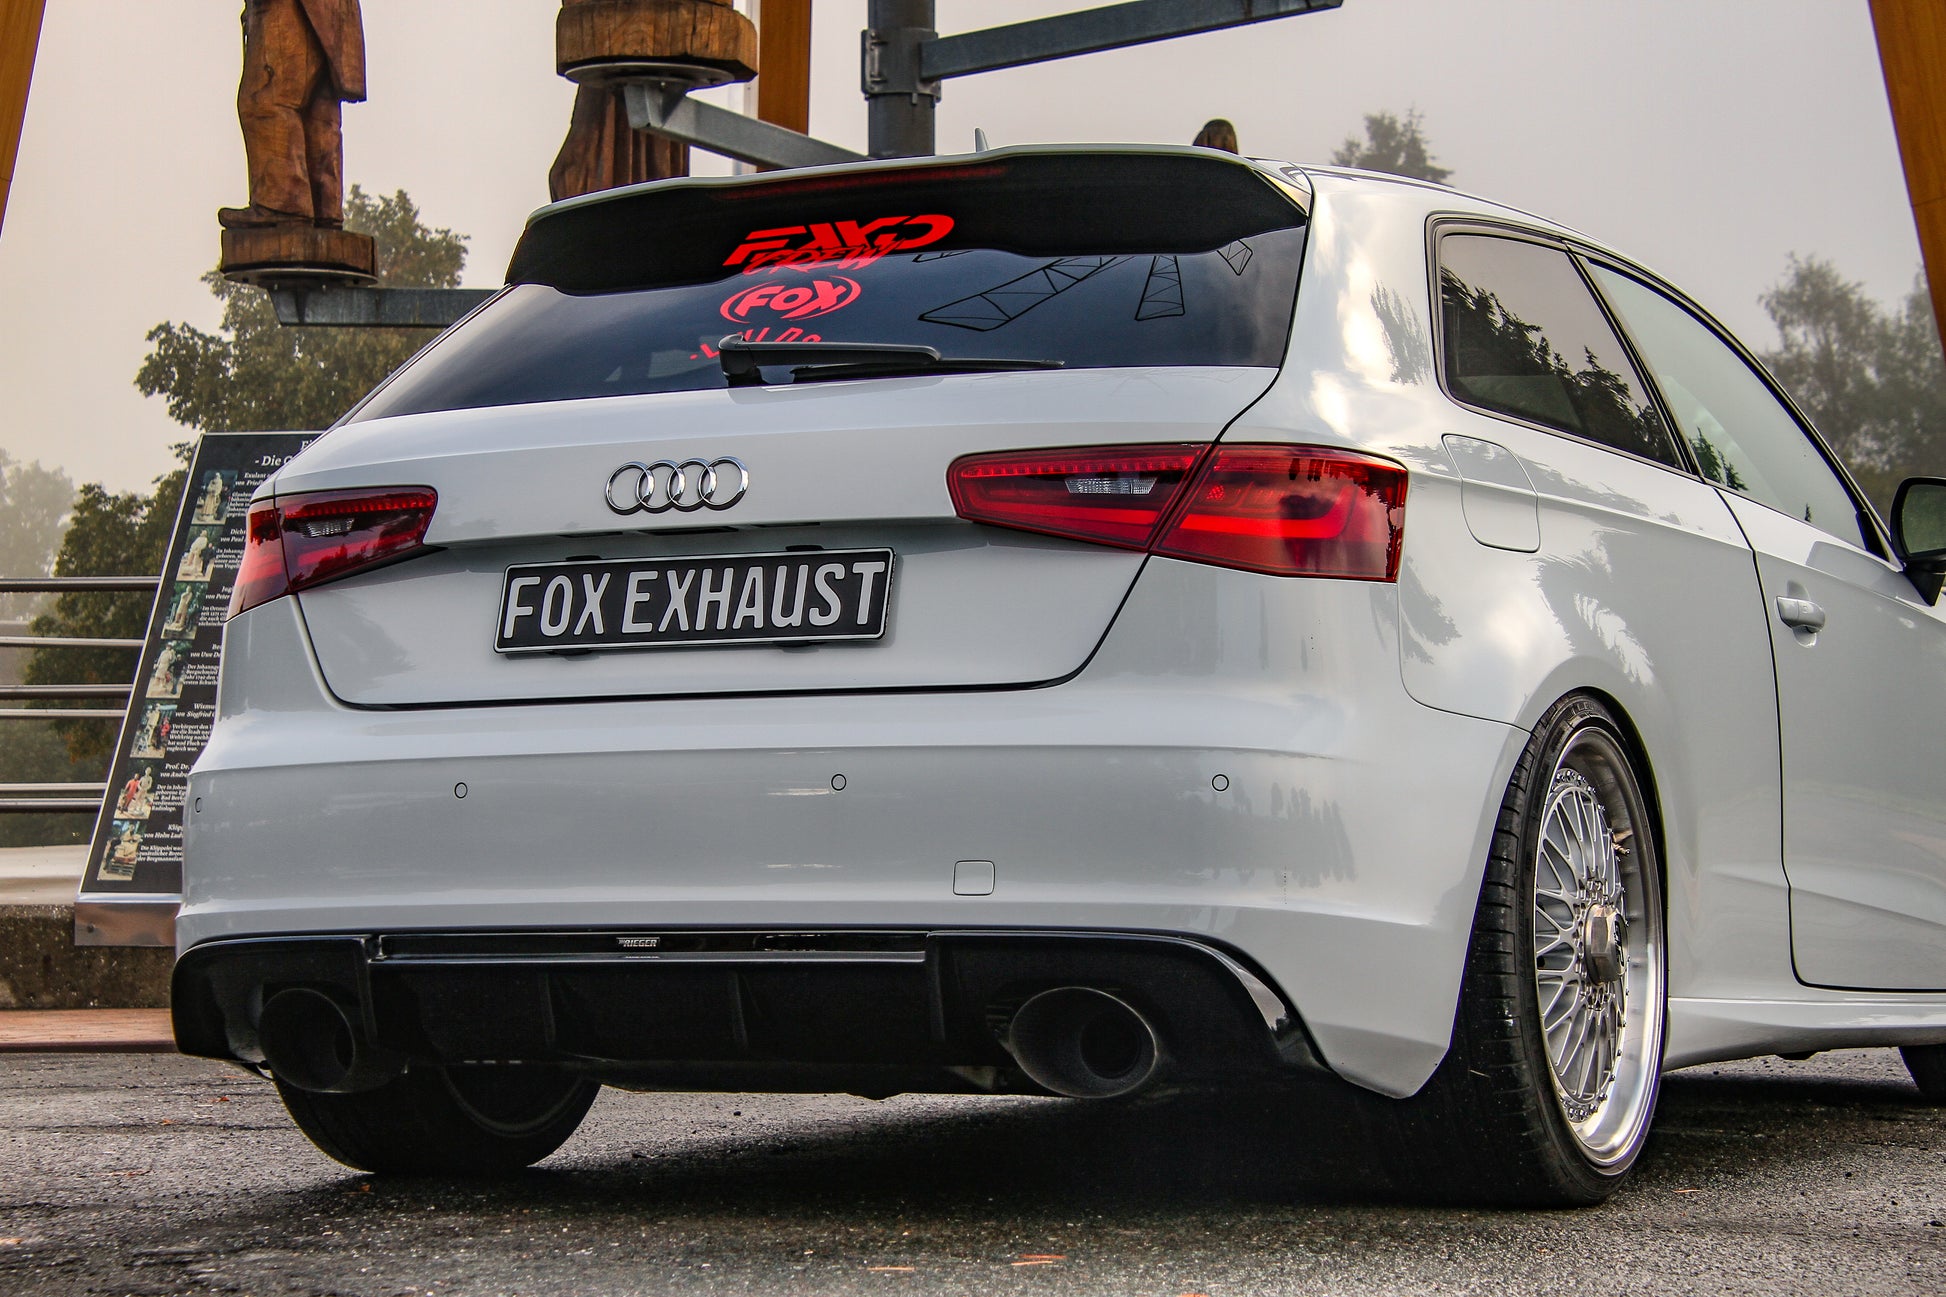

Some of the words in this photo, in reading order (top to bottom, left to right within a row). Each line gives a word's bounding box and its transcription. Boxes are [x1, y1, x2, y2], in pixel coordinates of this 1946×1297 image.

[733, 280, 847, 320] FOX
[261, 455, 282, 467] Die
[503, 572, 611, 639] FOX
[621, 561, 886, 634] EXHAUST
[186, 711, 212, 719] Siegfried
[622, 939, 658, 947] RIEGER
